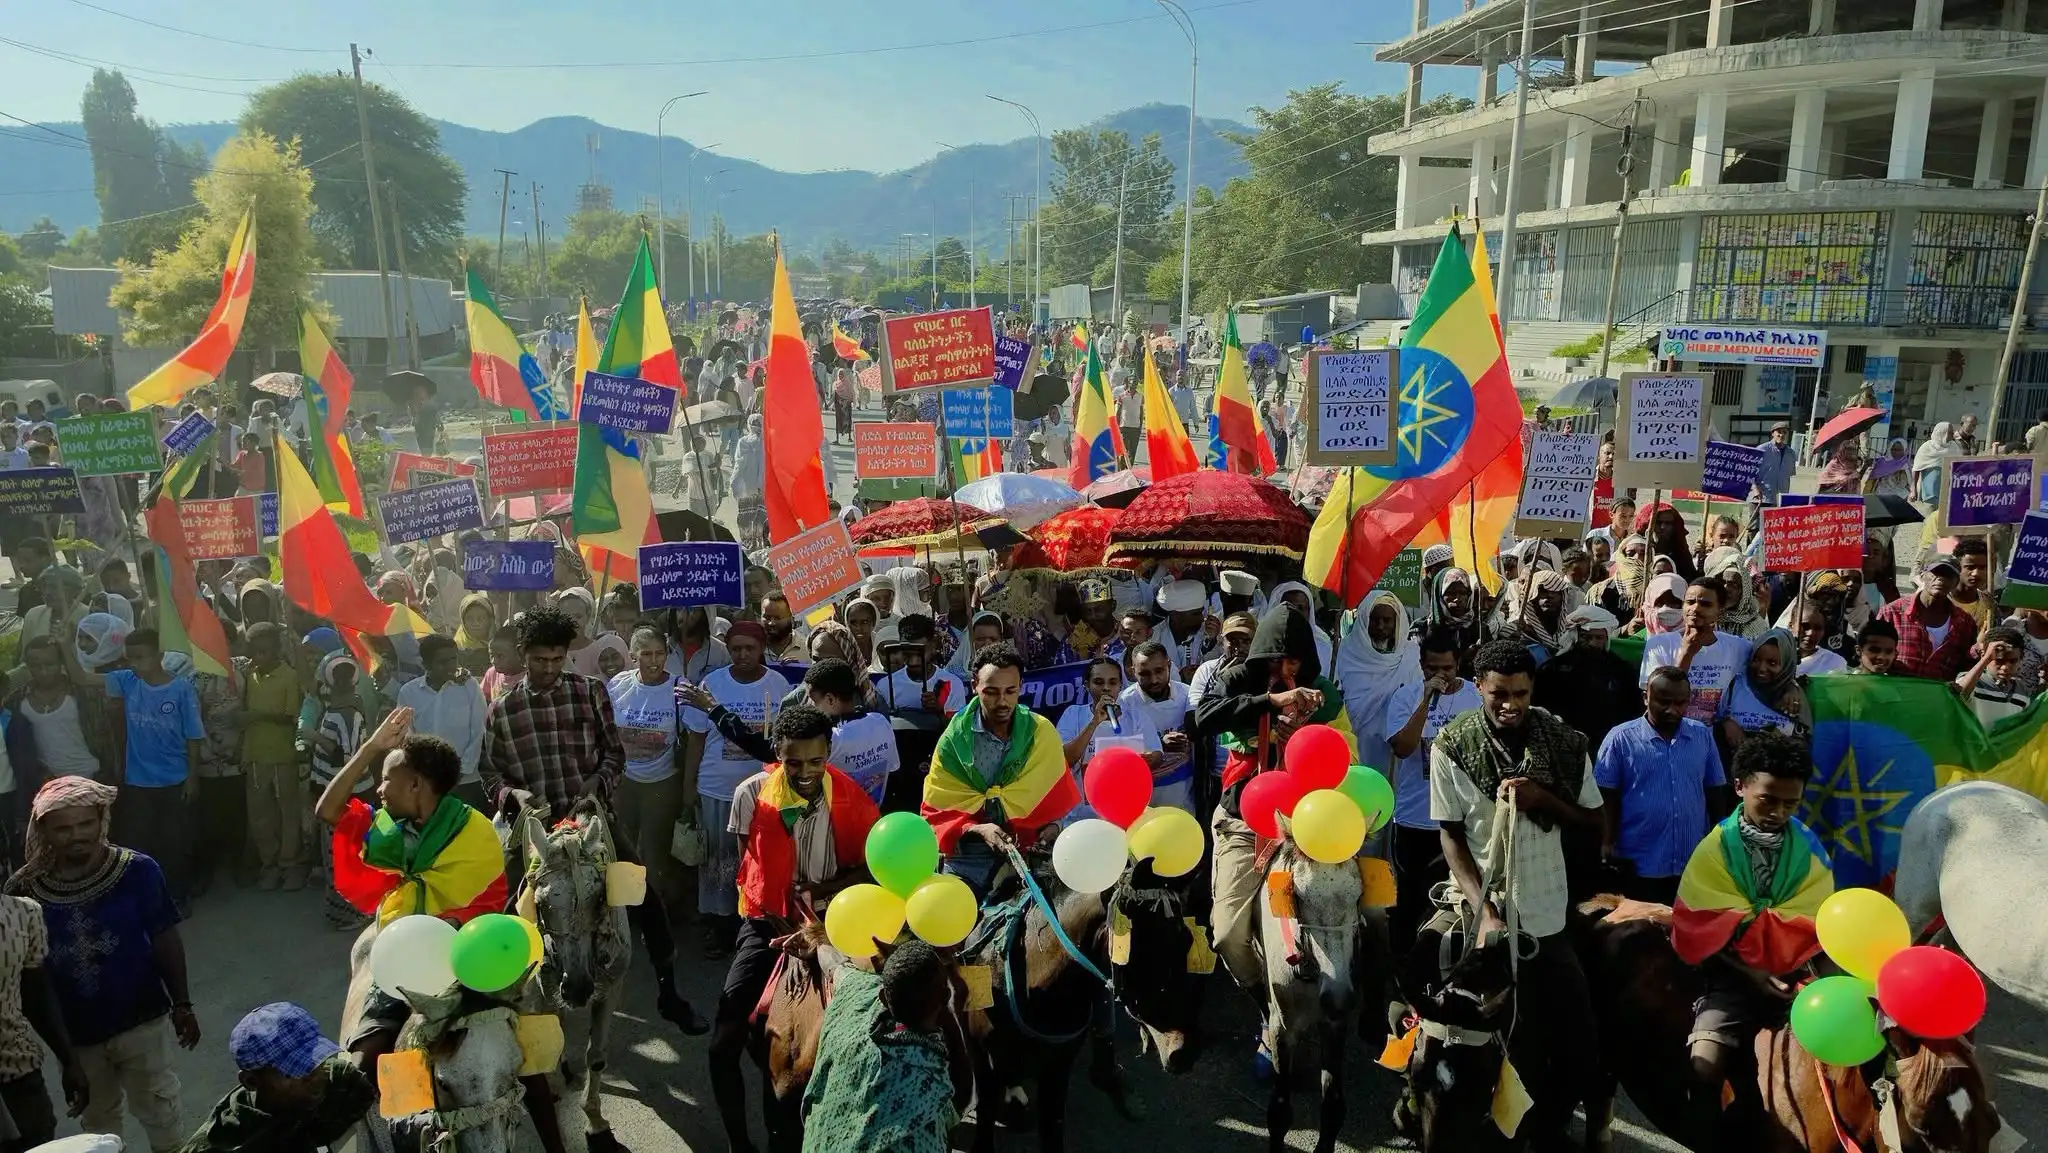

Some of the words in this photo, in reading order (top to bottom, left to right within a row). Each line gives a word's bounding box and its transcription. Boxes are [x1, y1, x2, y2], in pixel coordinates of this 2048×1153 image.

[913, 319, 945, 333] የባህር
[950, 315, 967, 328] በር
[1666, 328, 1699, 341] ህብር
[1704, 330, 1765, 345] መካከለኛ
[1686, 343, 1721, 353] HIBER
[1724, 344, 1773, 355] MEDIUM
[1776, 347, 1820, 357] CLINIC
[1339, 420, 1369, 431] ወደ
[1650, 436, 1679, 446] ወደ
[1541, 494, 1569, 504] ወደ
